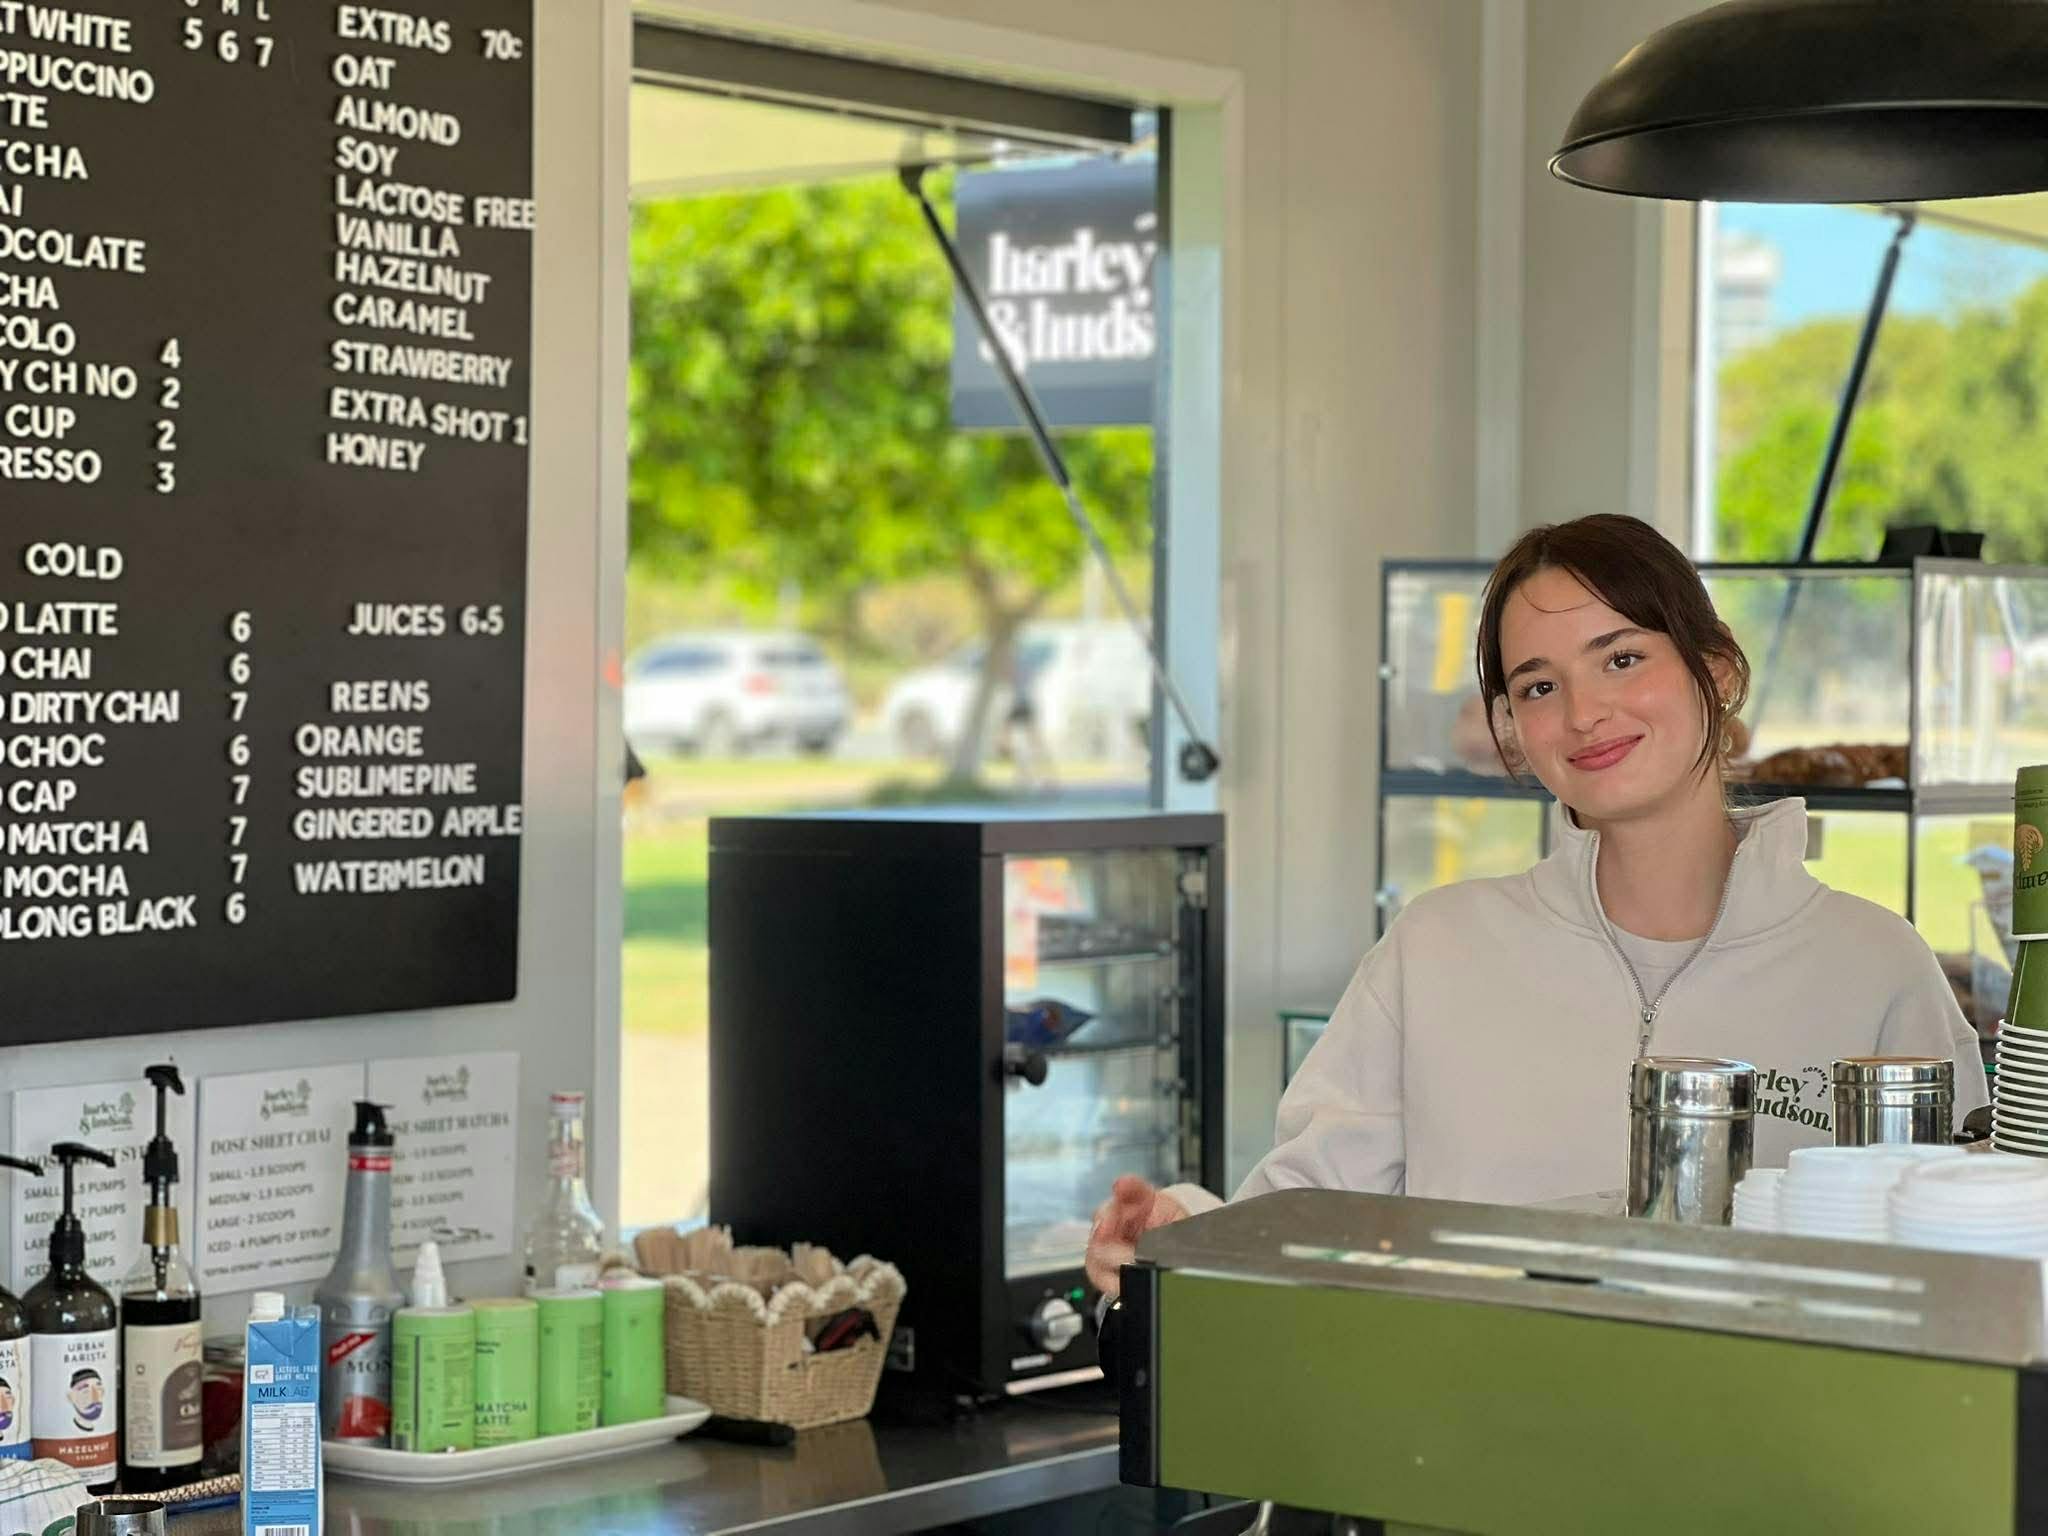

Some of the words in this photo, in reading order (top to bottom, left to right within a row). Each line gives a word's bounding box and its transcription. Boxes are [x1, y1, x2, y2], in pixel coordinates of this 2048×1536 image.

[27, 5, 132, 53] WHITE
[184, 17, 203, 50] 5
[219, 31, 239, 62] 6
[255, 37, 274, 68] 7
[338, 5, 452, 54] EXTRAS
[333, 53, 396, 90] OAT
[336, 95, 461, 146] ALMOND
[336, 135, 398, 177] SOY
[336, 174, 465, 225] LACTOSE
[474, 196, 536, 230] FREE
[337, 212, 460, 258] VANILLA
[336, 250, 492, 304] HAZELNUT
[334, 292, 475, 341] CARAMEL
[161, 338, 181, 369] 4
[332, 339, 512, 388] STRAWBERRY
[161, 377, 180, 409] 2
[5, 404, 76, 439] CUP
[157, 419, 177, 451] 2
[330, 386, 428, 428] EXTRA
[431, 403, 510, 442] SHOT
[513, 416, 528, 446] 1
[327, 432, 426, 472] HONEY
[157, 461, 176, 493] 3
[26, 542, 123, 580] COLD
[15, 602, 119, 636] LATTE
[232, 611, 251, 643] 6
[348, 602, 446, 636] JUICES
[11, 646, 92, 680] CHAI
[231, 652, 251, 684] 6
[231, 691, 248, 722] 7
[331, 680, 431, 713] REENS
[7, 732, 106, 769] CHOC
[230, 734, 251, 766] 6
[296, 723, 424, 757] ORANGE
[8, 779, 77, 814] CAP
[231, 774, 251, 805] 7
[297, 763, 477, 798] SUBLIMEPINE
[230, 816, 248, 846] 7
[294, 807, 434, 841] GINGERED
[441, 804, 522, 838] APPLE
[3, 863, 130, 898] MOCHA
[230, 853, 248, 884] 7
[294, 854, 485, 894] WATERMELON
[1, 904, 93, 940] LONG
[98, 894, 197, 936] BLACK
[227, 892, 246, 924] 6
[210, 1137, 246, 1156] DOSE
[250, 1131, 293, 1151] SHEET
[63, 1351, 107, 1364] BARISTA
[67, 1341, 105, 1353] URBAN
[58, 1441, 110, 1455] HAZELNUT
